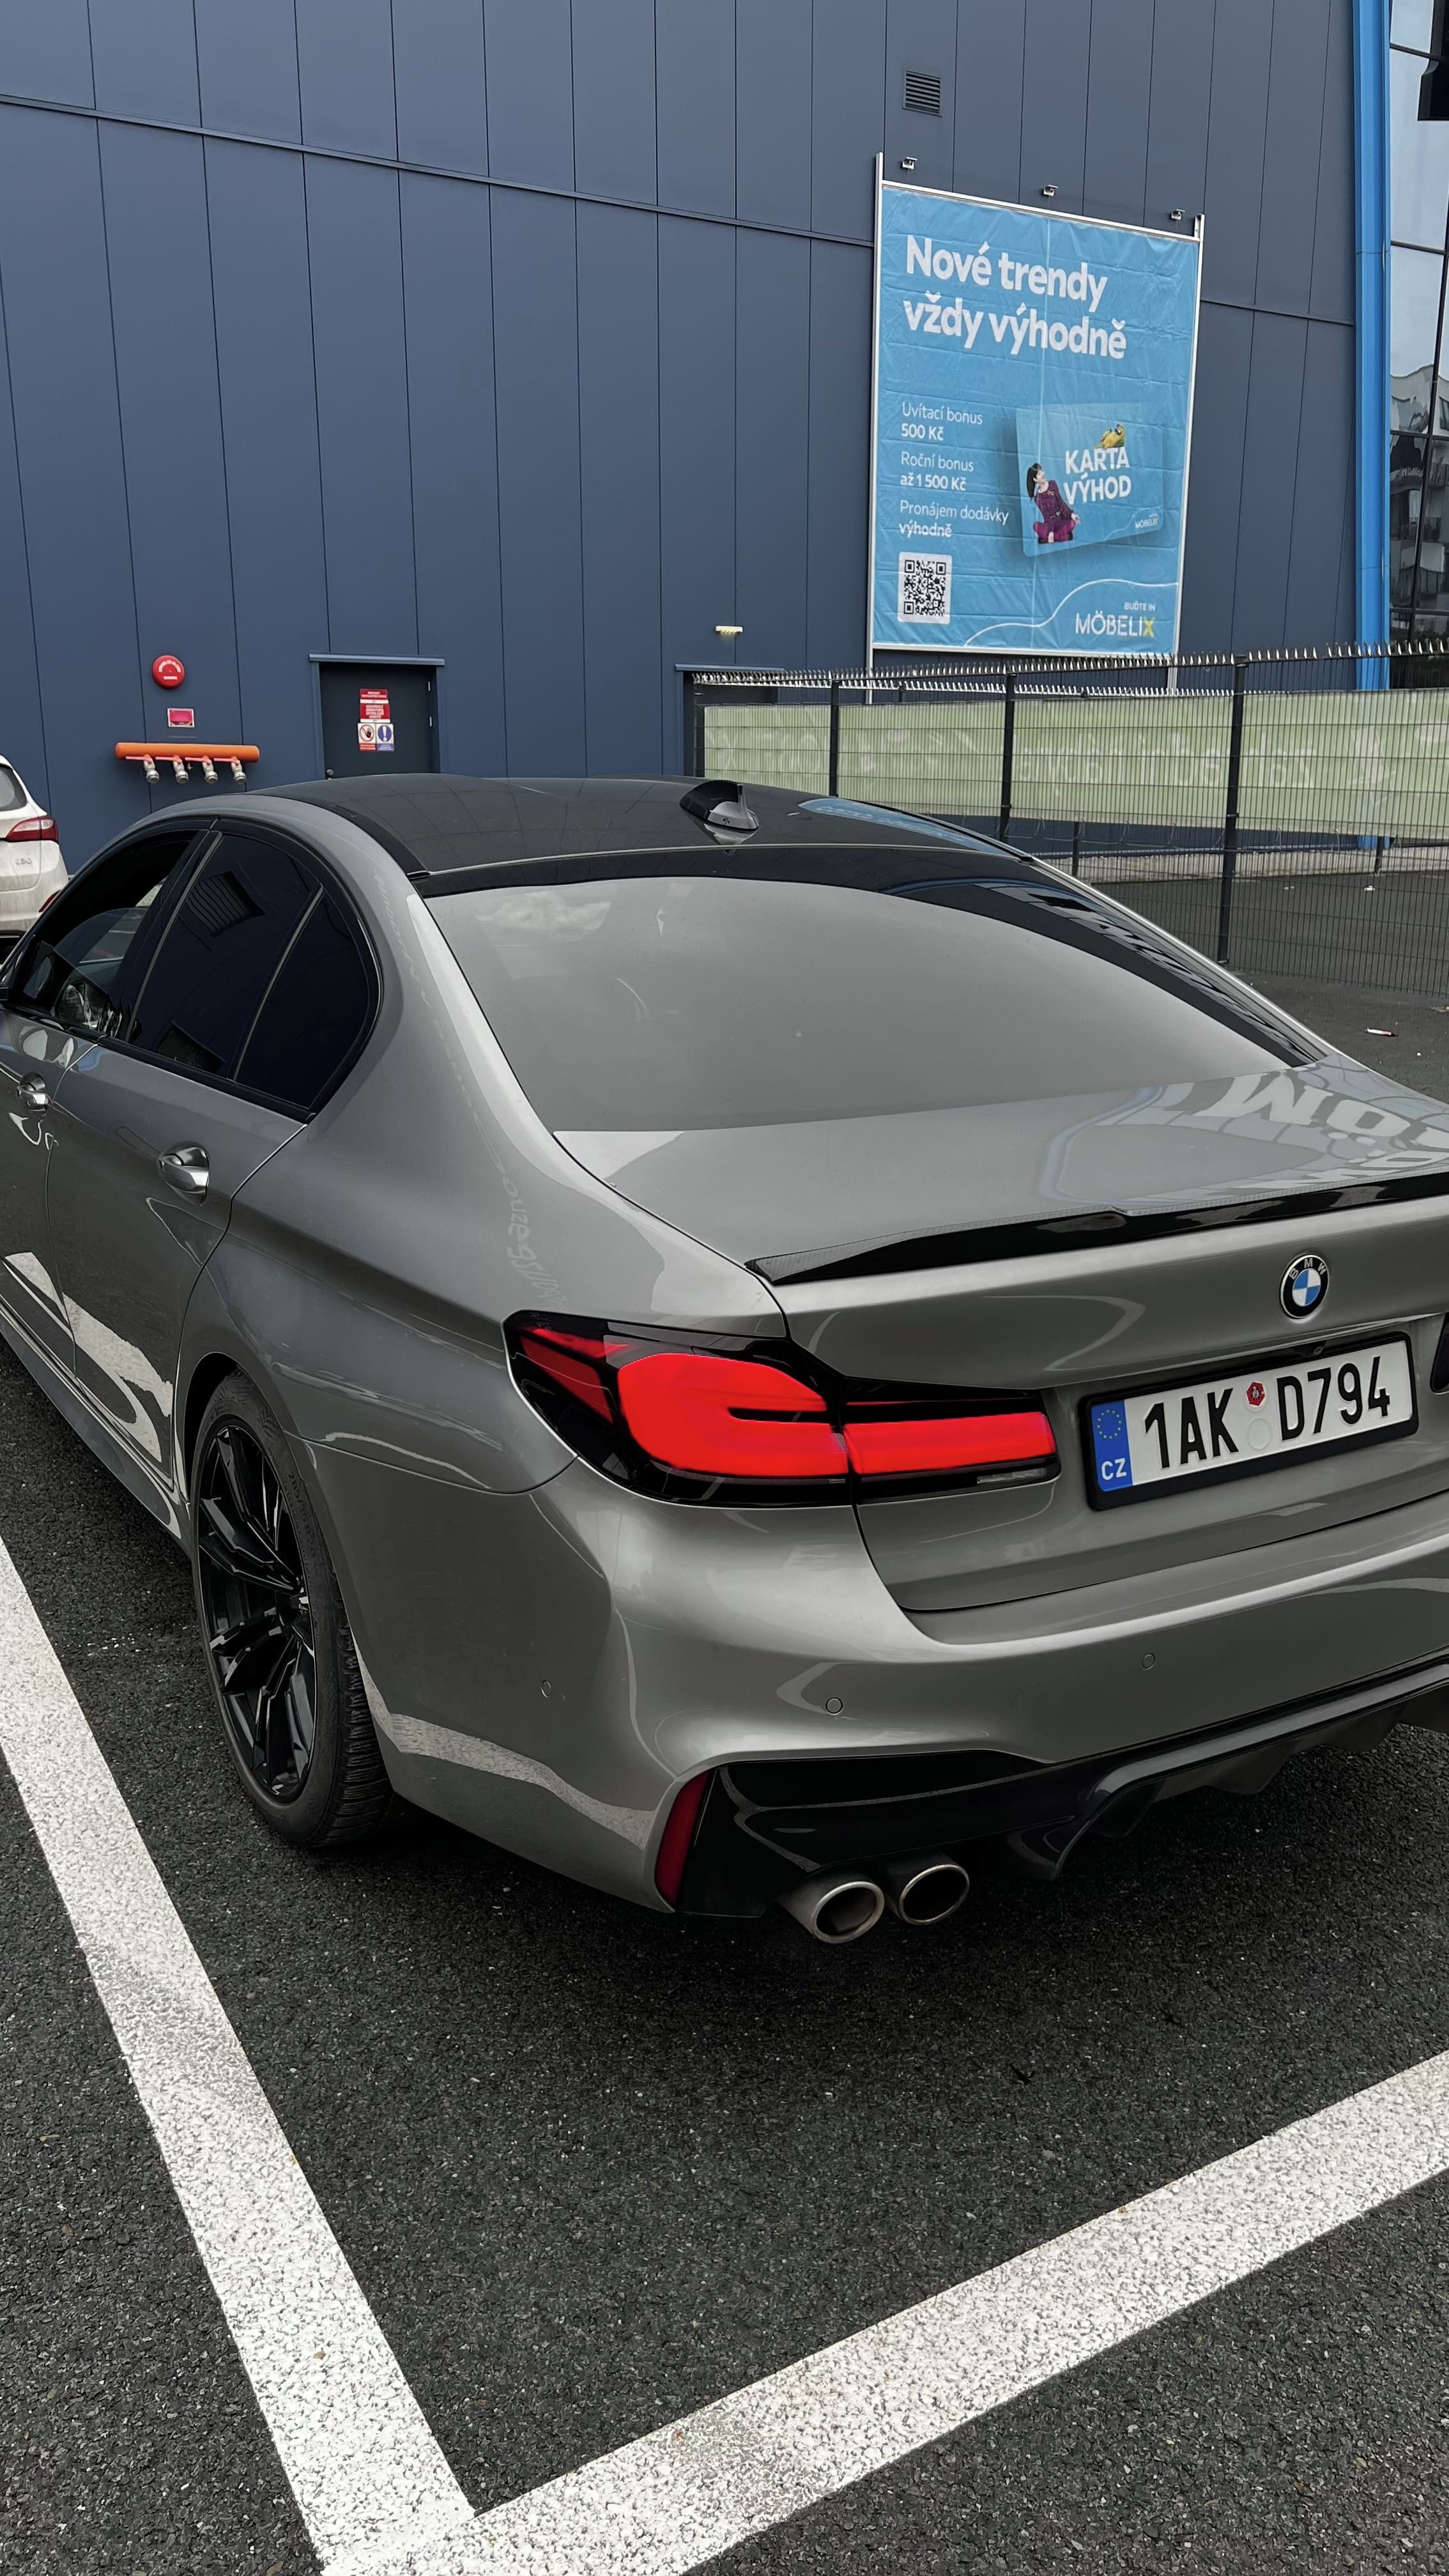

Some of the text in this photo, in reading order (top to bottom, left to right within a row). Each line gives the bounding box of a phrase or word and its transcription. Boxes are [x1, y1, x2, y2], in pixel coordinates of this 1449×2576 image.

[906, 234, 1108, 312] Nové trendy
[903, 289, 1127, 359] vždy výhodně
[901, 402, 983, 425] Uvítací bonus
[901, 423, 944, 441] 500 Kč
[901, 451, 974, 472] Roční bonus
[1064, 446, 1130, 475] KARTA
[900, 472, 914, 486] až
[951, 477, 967, 491] Kč
[1062, 472, 1132, 505] VÝHOD
[900, 500, 1009, 526] Pronájem dodávky
[899, 519, 952, 538] výhodně
[1075, 610, 1155, 638] MÖBELIX
[1288, 1257, 1327, 1280] BMW
[1144, 1356, 1390, 1469] 1AK D794
[1101, 1458, 1127, 1481] CZ
